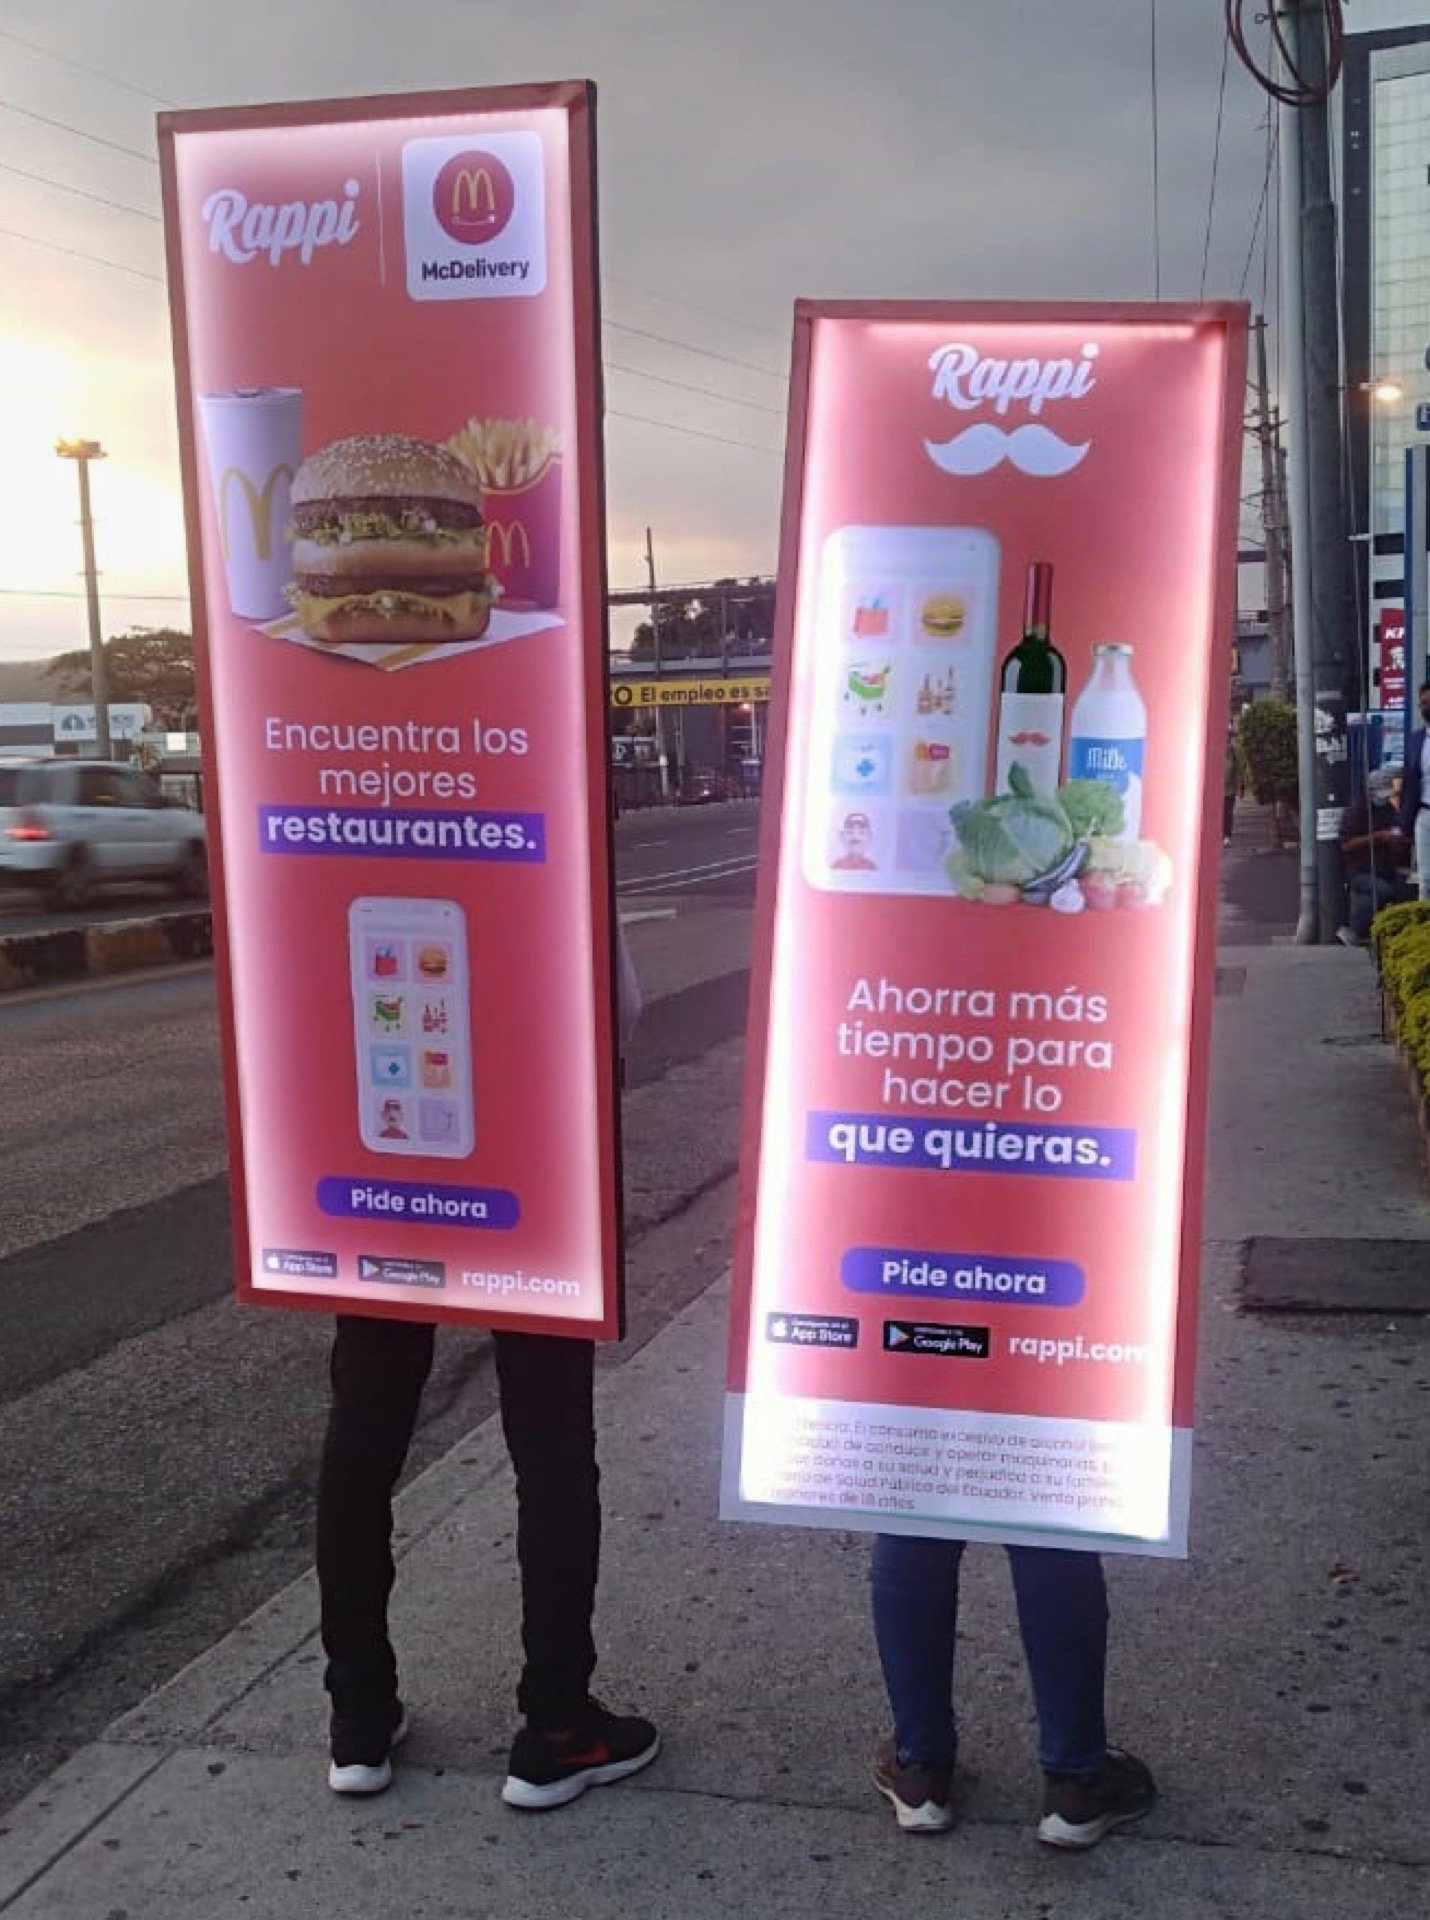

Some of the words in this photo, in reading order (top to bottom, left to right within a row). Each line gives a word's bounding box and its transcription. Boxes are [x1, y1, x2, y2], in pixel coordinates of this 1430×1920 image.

[202, 180, 359, 267] Rappi
[421, 256, 529, 283] McDelivery
[927, 342, 1099, 415] Rappi
[640, 686, 656, 703] El
[661, 685, 725, 704] empleo
[730, 687, 749, 699] es
[265, 717, 458, 753] Encuentra
[472, 719, 528, 755] los
[1088, 746, 1127, 771] Milk
[319, 761, 477, 807] mejores
[266, 812, 537, 849] restaurantes.
[846, 978, 995, 1016] Ahorra
[1009, 984, 1108, 1022] más
[838, 1020, 993, 1072] tiempo
[1007, 1036, 1114, 1077] para
[882, 1067, 1010, 1109] hacer
[1024, 1075, 1062, 1112] lo
[827, 1122, 915, 1163] que
[923, 1122, 1113, 1169] quieras.
[350, 1188, 405, 1213] Pide
[410, 1193, 488, 1219] ahora
[460, 1270, 582, 1297] rappi.com
[881, 1260, 947, 1288] Pide
[953, 1265, 1047, 1294] ahora
[791, 1326, 817, 1343] App
[818, 1328, 852, 1344] Store
[912, 1335, 957, 1352] Google
[959, 1337, 983, 1354] Play
